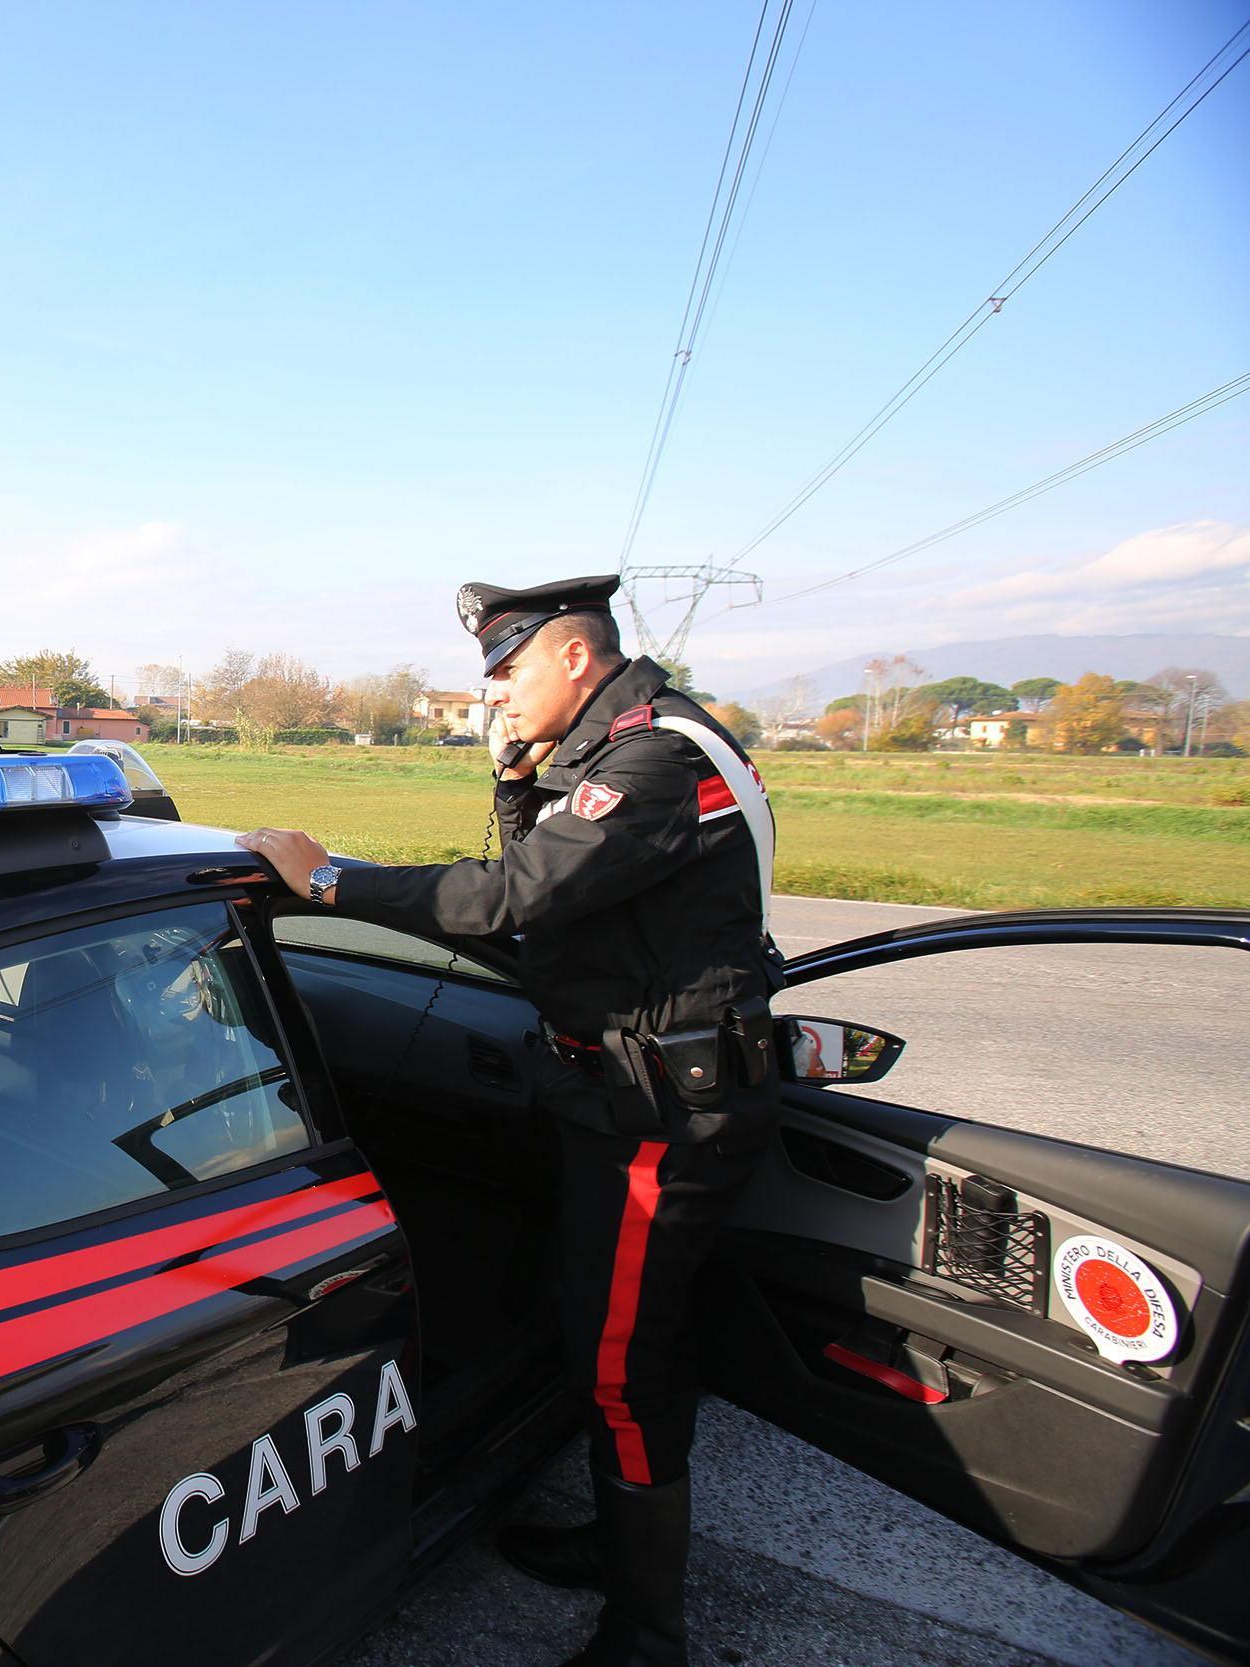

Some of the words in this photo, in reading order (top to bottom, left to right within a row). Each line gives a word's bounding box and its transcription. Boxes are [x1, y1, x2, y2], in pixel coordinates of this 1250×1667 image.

[1061, 1245, 1090, 1299] MINISTERO
[1096, 1246, 1141, 1281] DELLA
[1145, 1289, 1165, 1338] DIFESA
[1084, 1316, 1148, 1350] CARABINIERI
[159, 1360, 417, 1577] CARA
